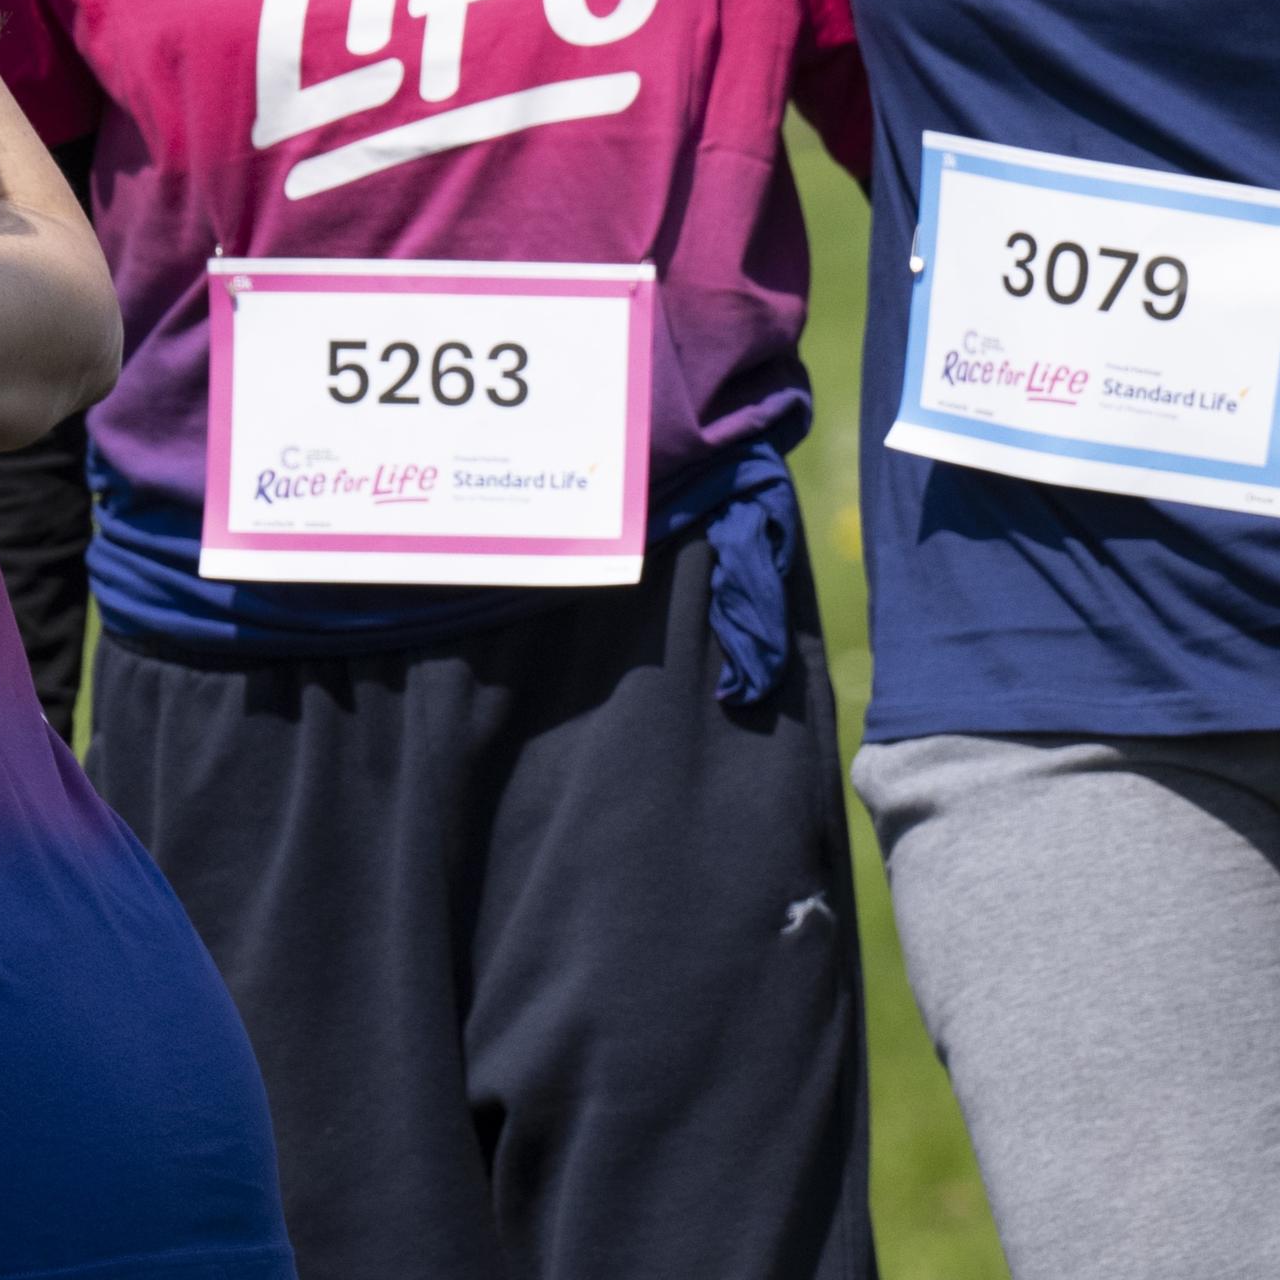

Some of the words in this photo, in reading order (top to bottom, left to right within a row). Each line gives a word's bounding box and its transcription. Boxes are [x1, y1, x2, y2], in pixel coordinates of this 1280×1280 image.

[1001, 231, 1189, 322] 3079
[326, 340, 529, 408] 5263
[942, 350, 994, 386] Race
[996, 360, 1025, 385] for
[1026, 361, 1090, 395] Life
[1102, 377, 1195, 407] Standard
[1199, 392, 1238, 413] Life
[254, 469, 327, 504] Race
[332, 468, 369, 494] for
[372, 464, 438, 496] Life
[453, 470, 545, 489] Standard
[549, 471, 589, 490] Life
